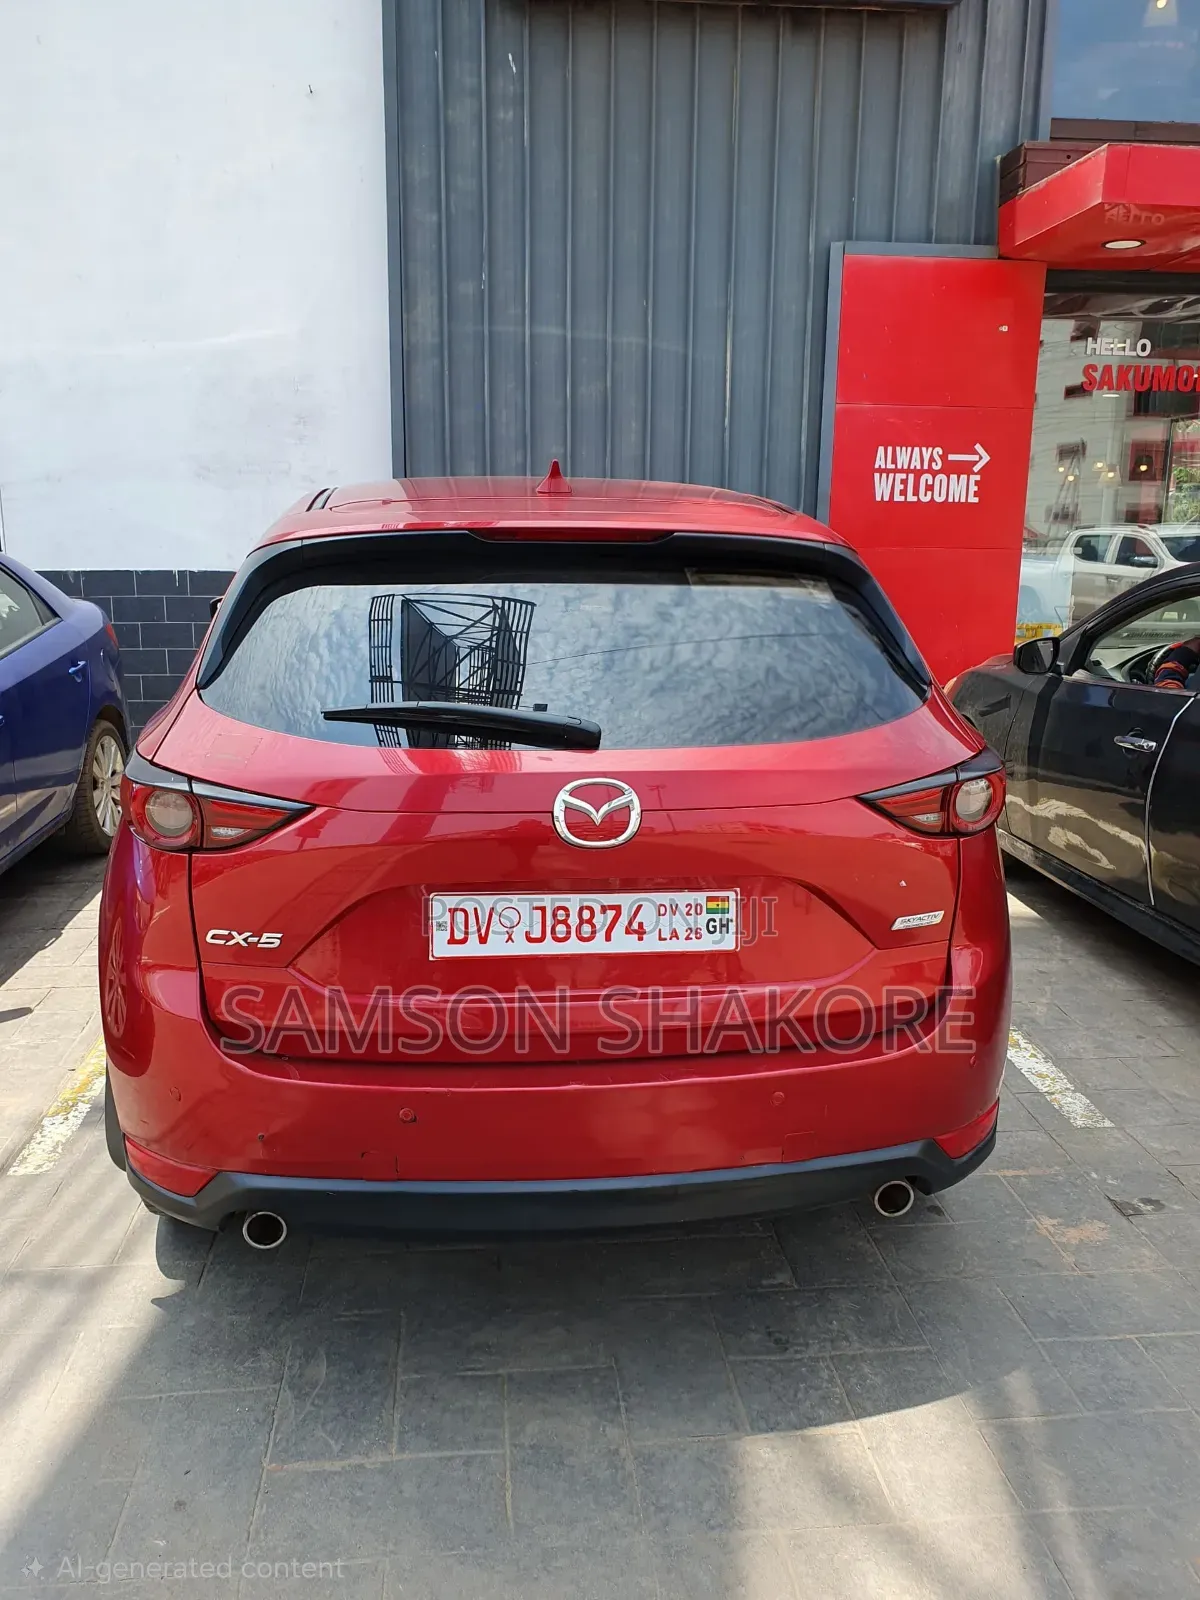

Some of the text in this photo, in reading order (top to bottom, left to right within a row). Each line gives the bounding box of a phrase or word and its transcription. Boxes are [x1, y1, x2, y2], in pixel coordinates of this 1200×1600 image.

[1086, 337, 1152, 357] HELLO
[1082, 363, 1200, 392] SAKUMO
[874, 446, 943, 470] ALWAYS
[874, 472, 981, 503] WELCOME
[657, 902, 704, 917] DV 20
[900, 913, 940, 924] SKYACTIV
[447, 906, 494, 945] DV
[525, 904, 647, 943] J8874
[657, 927, 703, 942] LA 26
[705, 917, 730, 935] GH
[205, 929, 284, 949] CX-5
